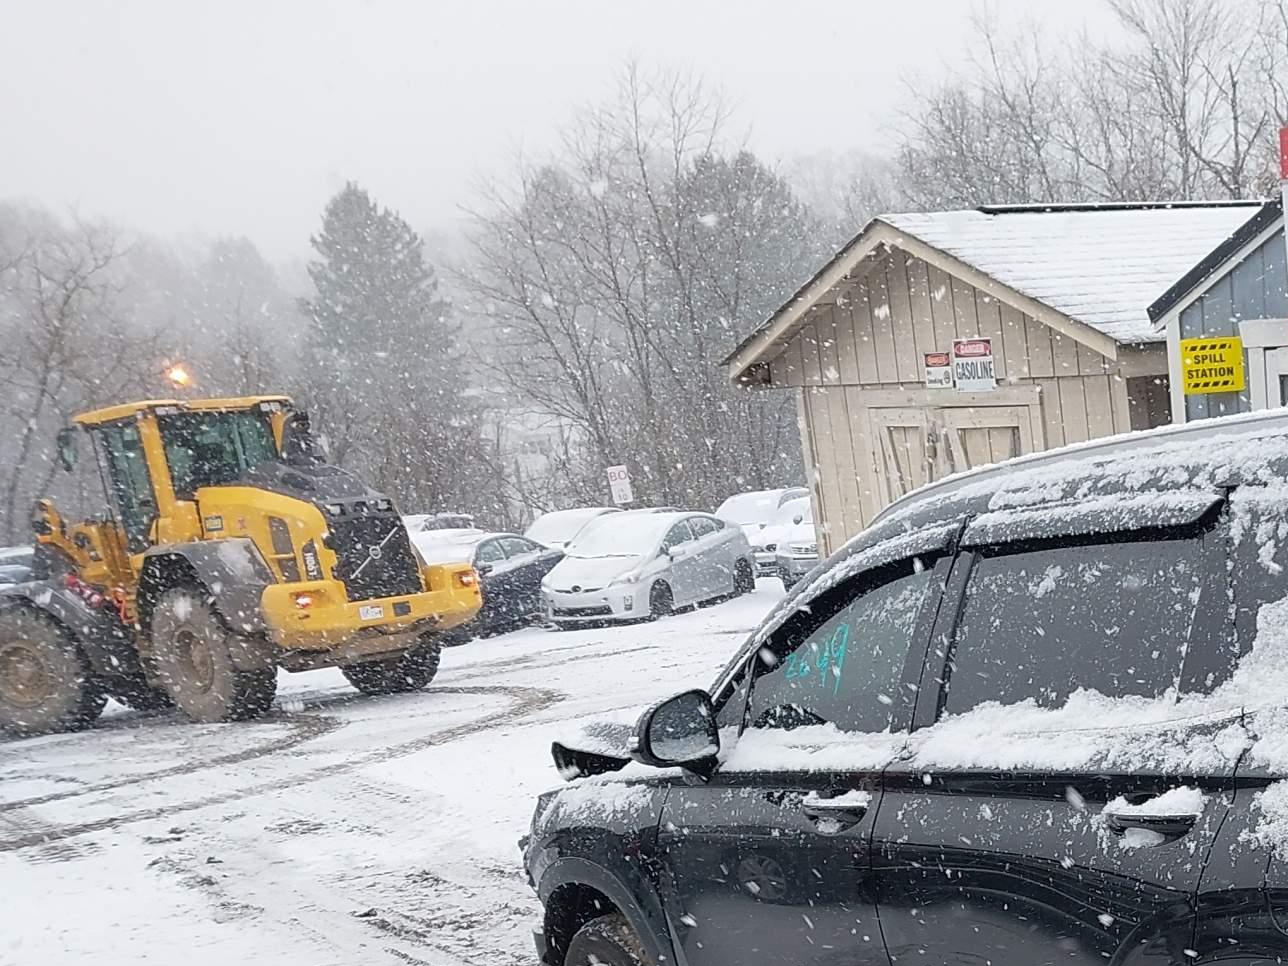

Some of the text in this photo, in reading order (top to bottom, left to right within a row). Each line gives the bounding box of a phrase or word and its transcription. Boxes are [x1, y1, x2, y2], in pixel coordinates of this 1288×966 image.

[1193, 353, 1226, 365] SPILL
[955, 360, 994, 380] GASOLINE
[1187, 366, 1234, 380] STATION
